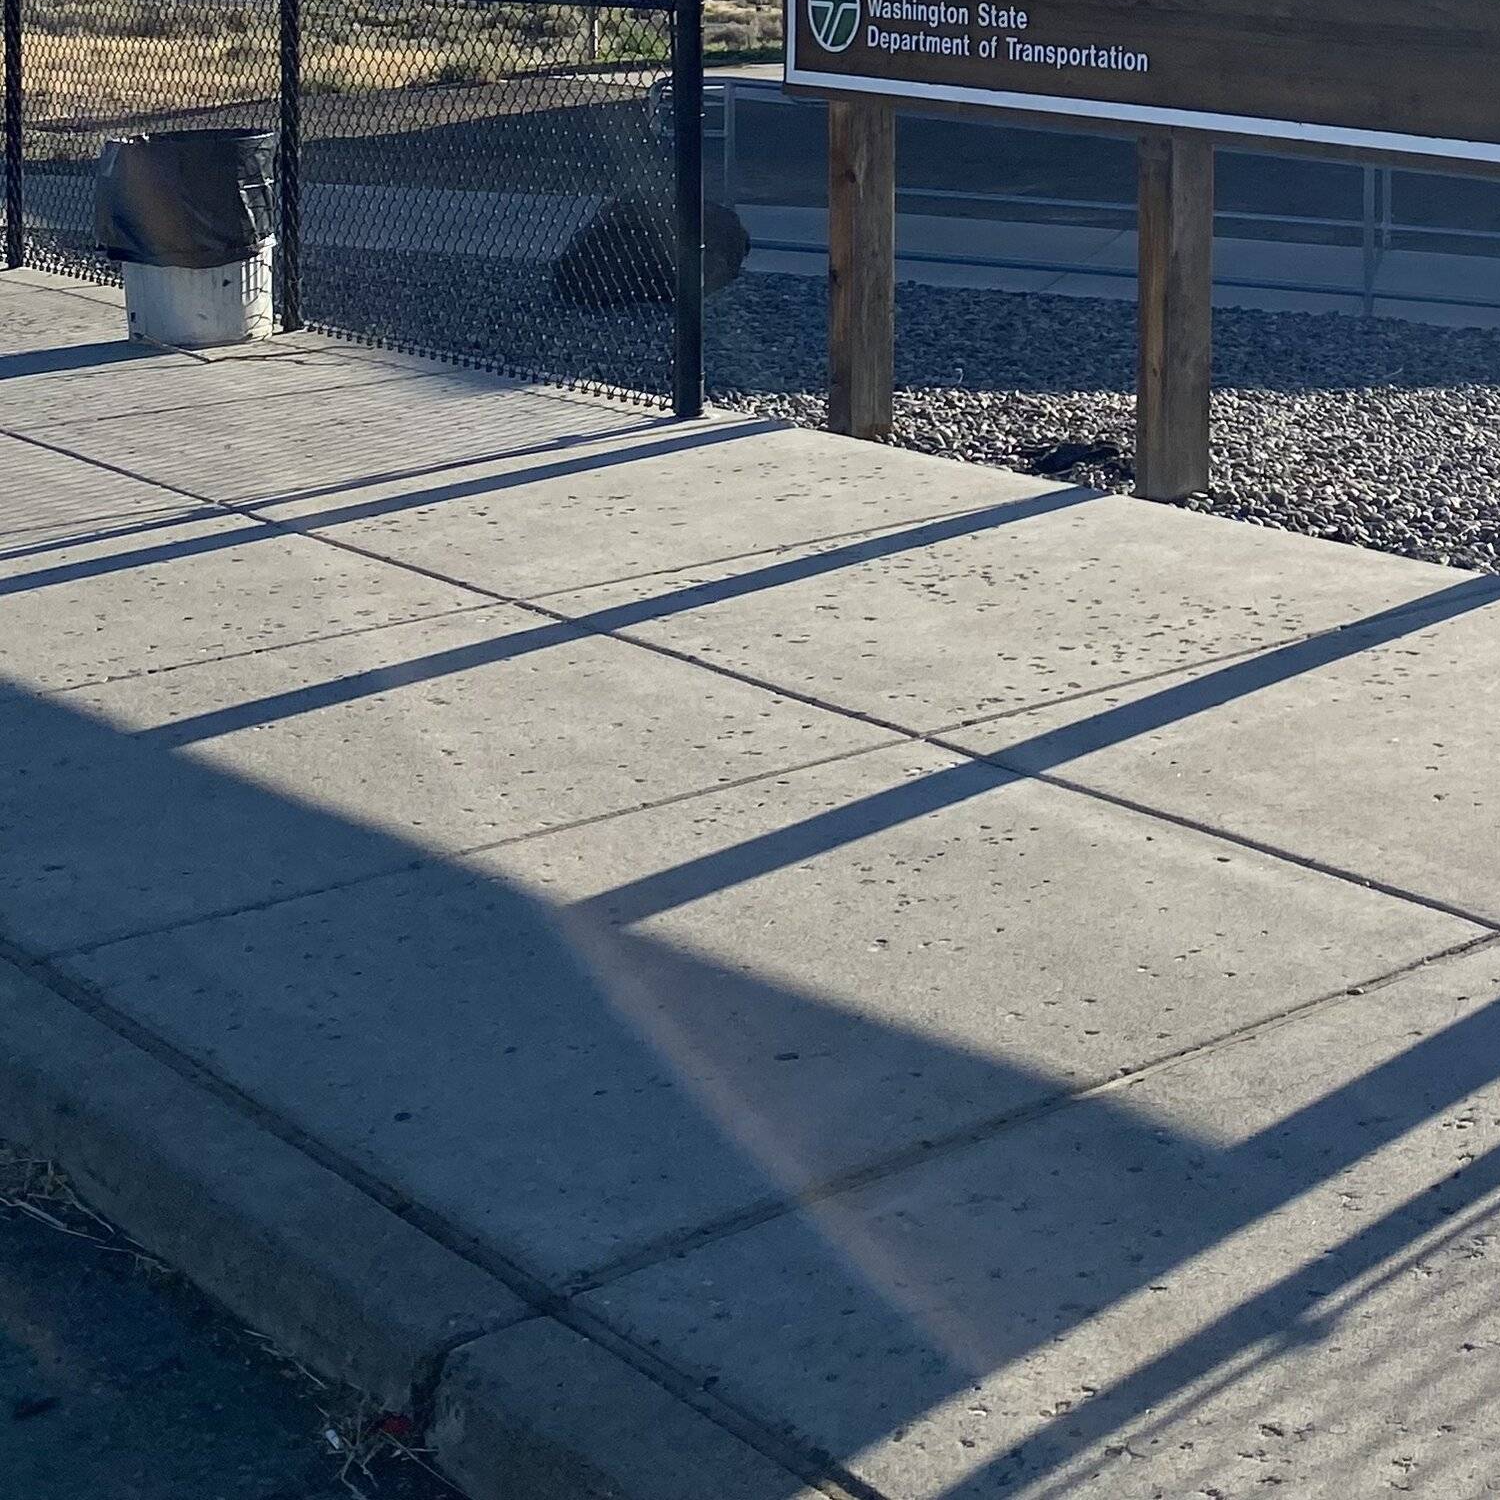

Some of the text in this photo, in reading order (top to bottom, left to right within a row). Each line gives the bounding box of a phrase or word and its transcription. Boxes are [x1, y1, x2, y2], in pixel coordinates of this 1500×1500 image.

[977, 2, 1028, 30] State
[867, 25, 1149, 73] Department of Transportation
